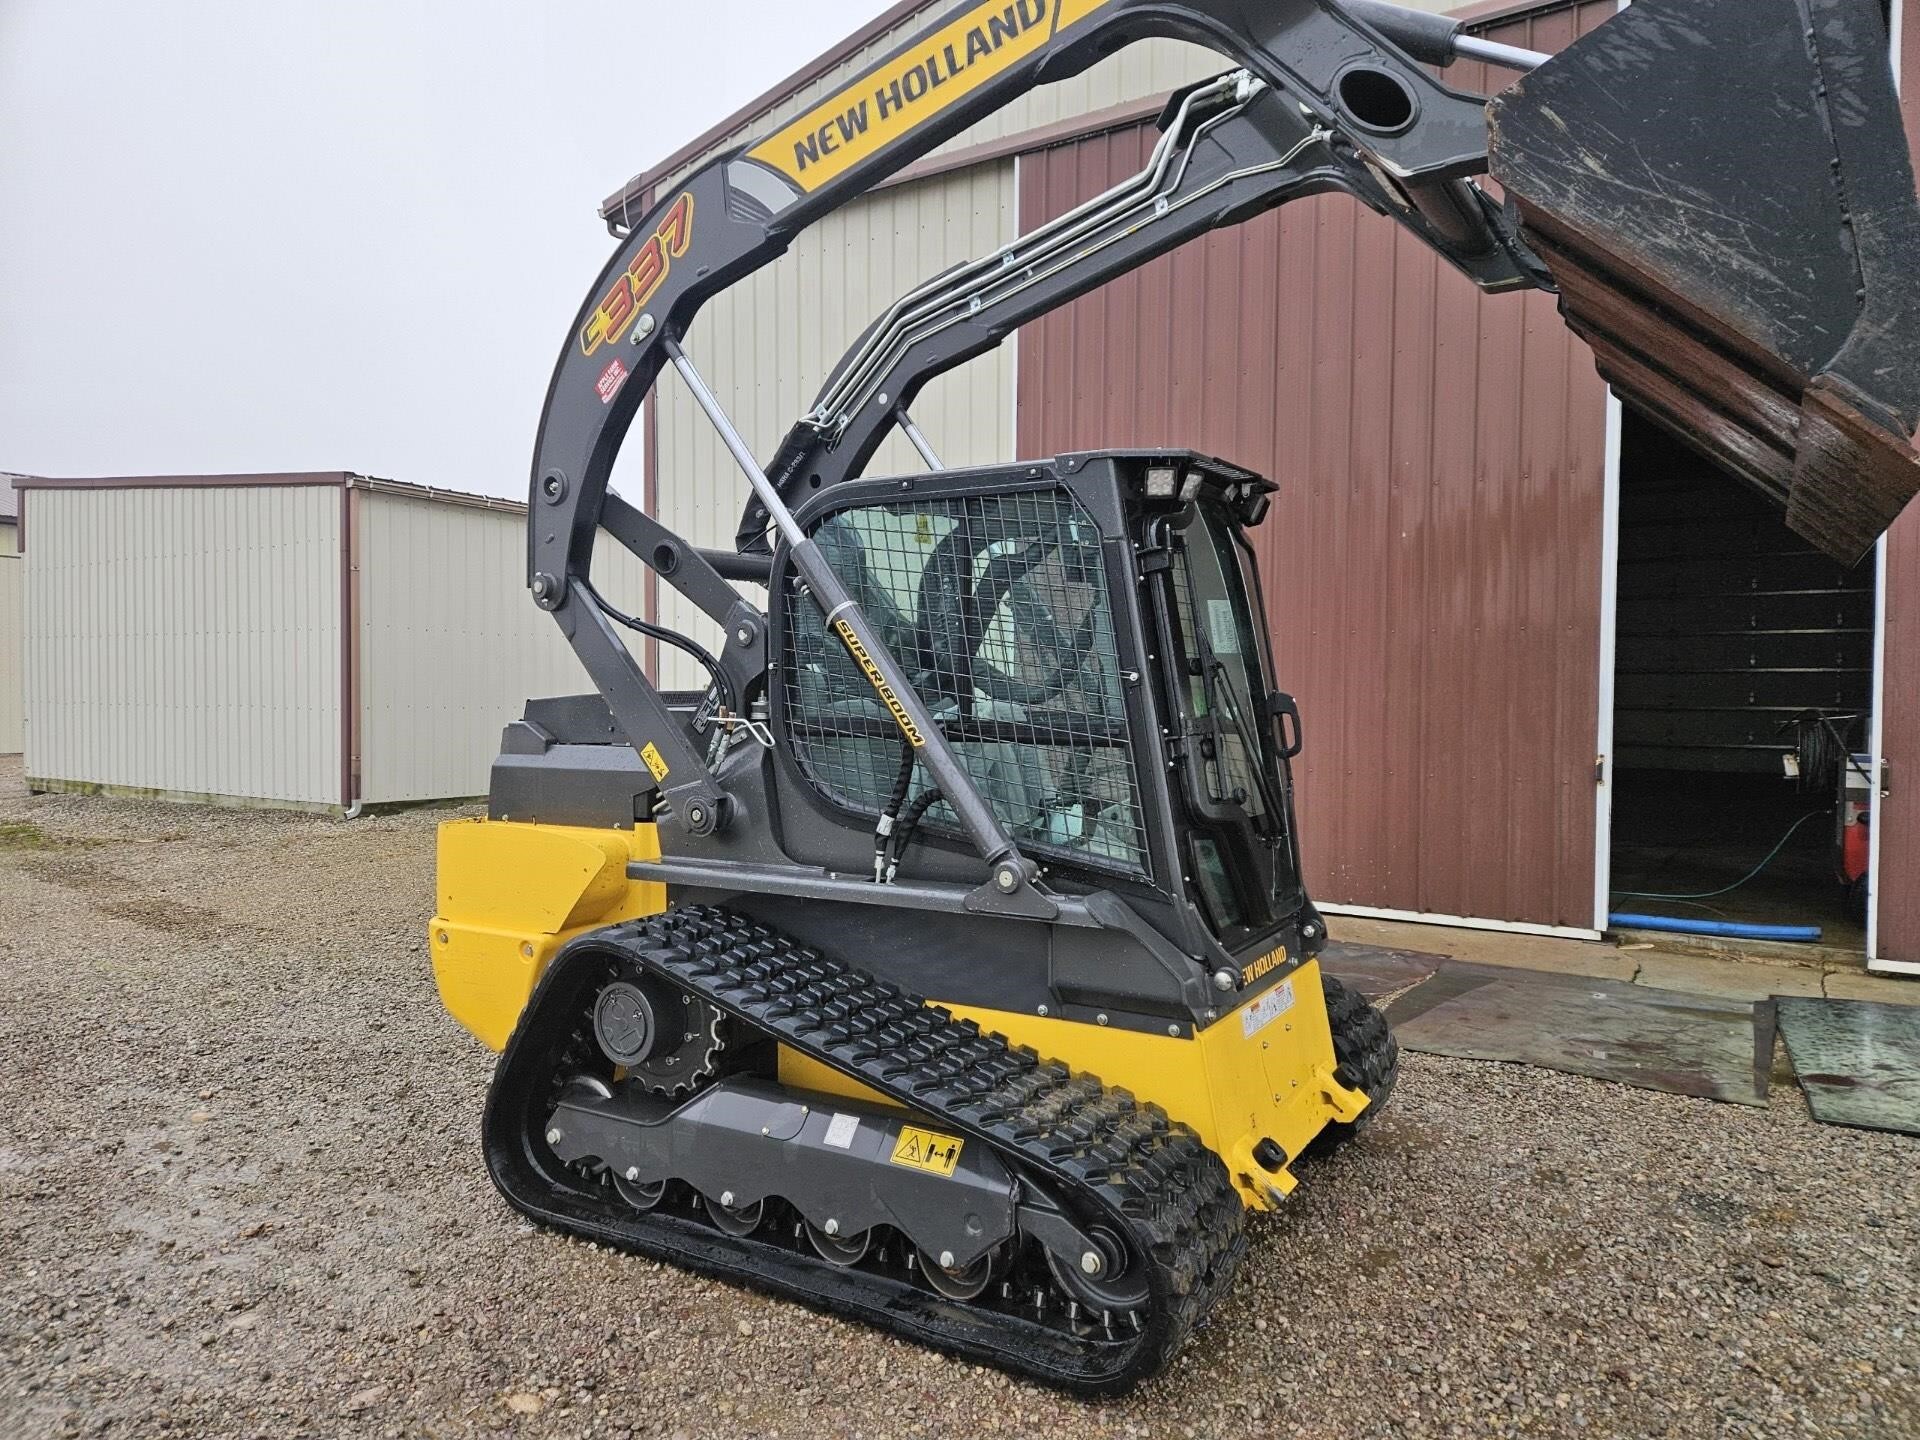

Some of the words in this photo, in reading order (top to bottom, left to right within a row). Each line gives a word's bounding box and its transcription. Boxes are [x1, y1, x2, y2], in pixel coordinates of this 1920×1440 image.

[793, 98, 868, 171] NEW
[874, 0, 1046, 121] HOLLAND
[580, 192, 694, 356] C337
[837, 620, 885, 687] SUPER
[880, 686, 925, 746] BOOM
[1253, 945, 1286, 978] HOLLAND
